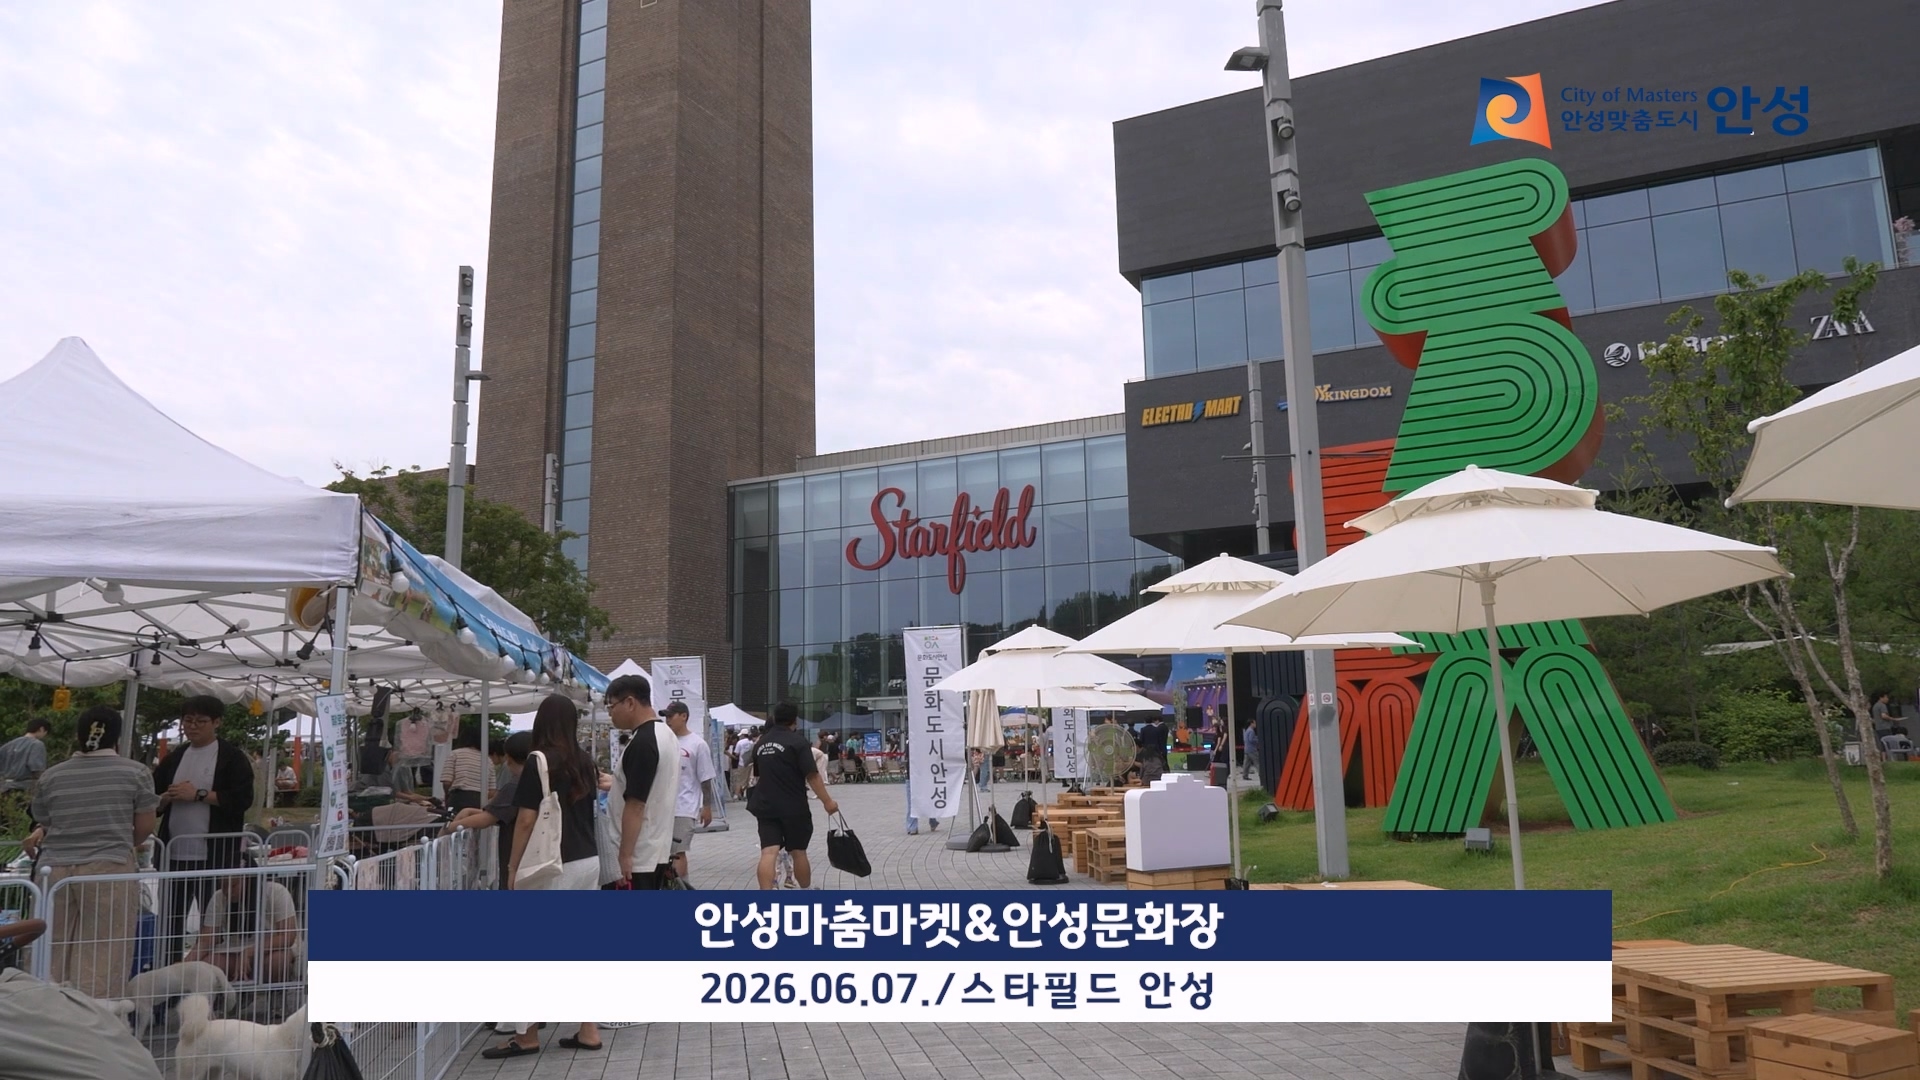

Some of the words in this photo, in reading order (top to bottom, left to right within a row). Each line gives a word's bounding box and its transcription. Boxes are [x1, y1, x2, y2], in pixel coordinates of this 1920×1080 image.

[1142, 402, 1194, 427] ELECTRO
[1204, 395, 1242, 419] MART
[845, 484, 1037, 595] Starfield
[922, 666, 948, 809] 문화도시안성
